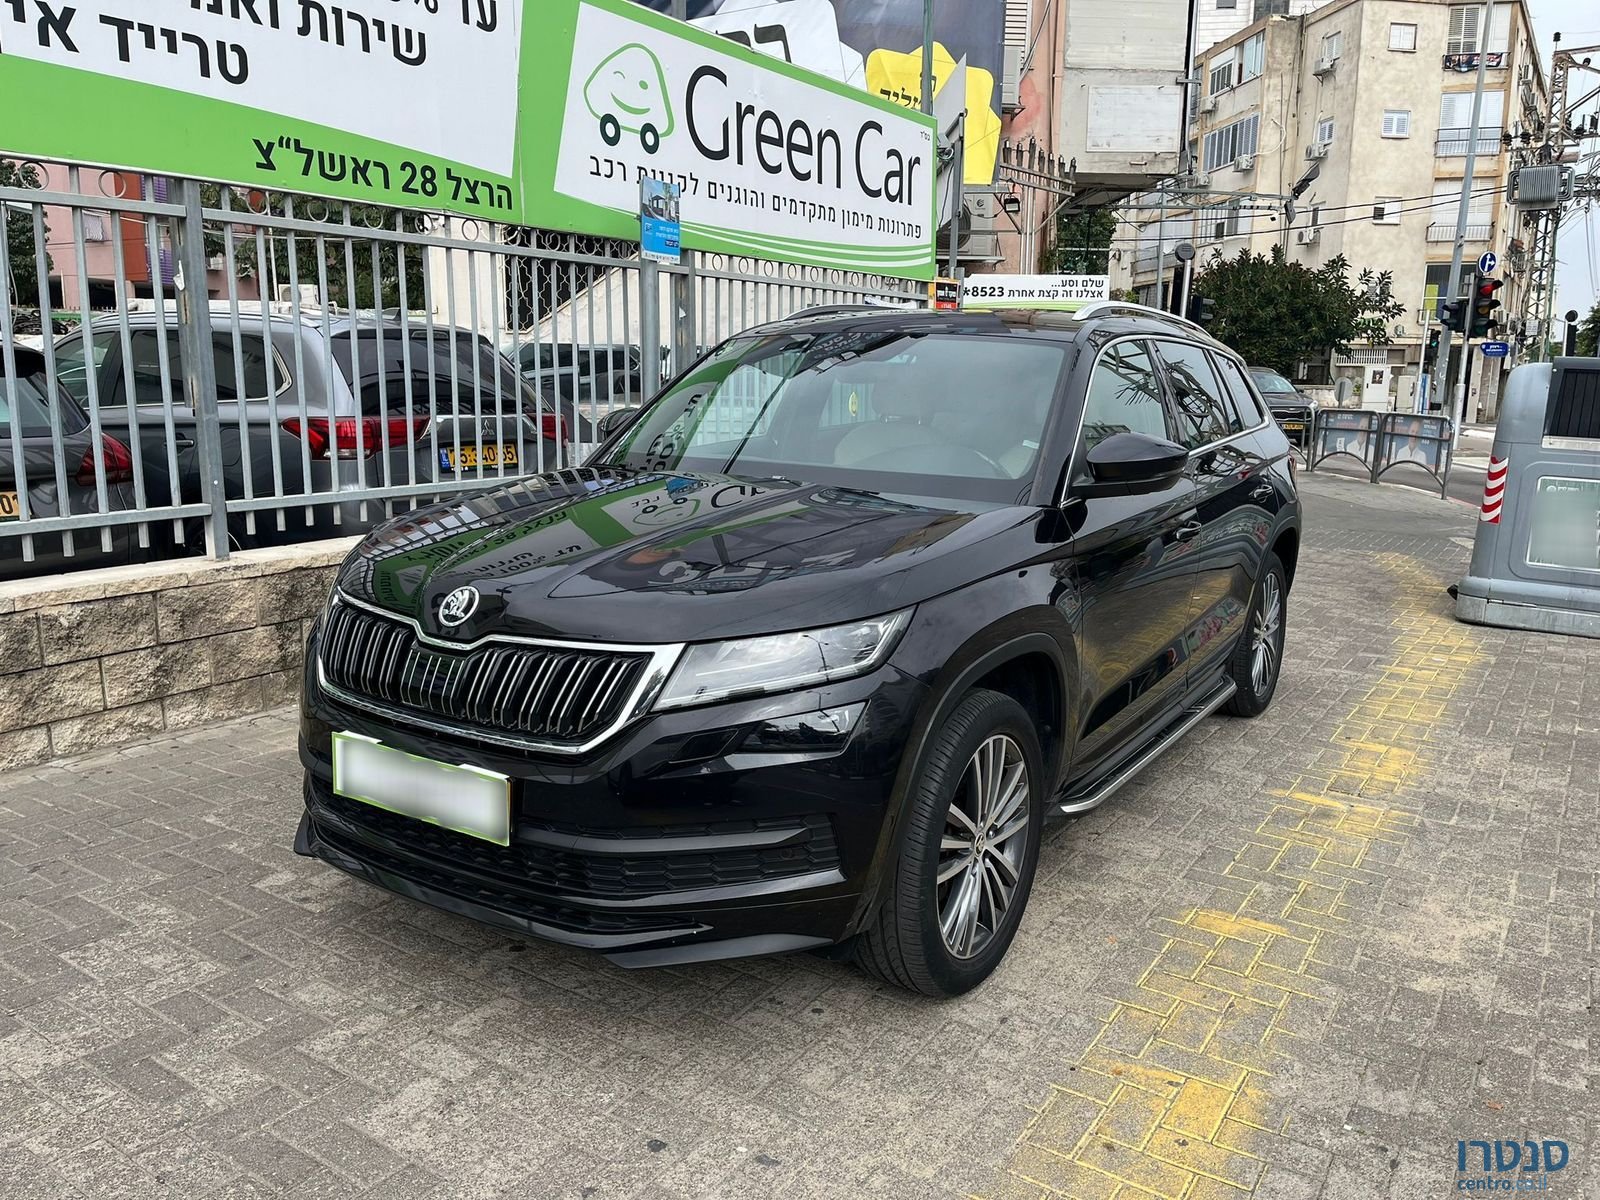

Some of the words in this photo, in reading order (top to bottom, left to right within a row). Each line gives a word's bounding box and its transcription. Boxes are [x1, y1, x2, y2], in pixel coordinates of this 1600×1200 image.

[297, 0, 427, 66] שירות
[98, 13, 249, 85] טרייד
[685, 64, 842, 189] Green
[855, 120, 921, 206] Car
[400, 161, 438, 197] 28
[589, 155, 627, 182] רכב
[445, 167, 513, 210] הרצל
[707, 180, 765, 209] והוגנים
[772, 194, 836, 223] מתקדמים
[841, 208, 873, 230] מימון
[878, 216, 922, 239] פתרונות
[1007, 289, 1035, 298] אחרת
[1037, 289, 1059, 300] קצת
[1061, 289, 1074, 298] זה
[1076, 288, 1104, 298] אצלנו
[1081, 277, 1104, 288] שלם
